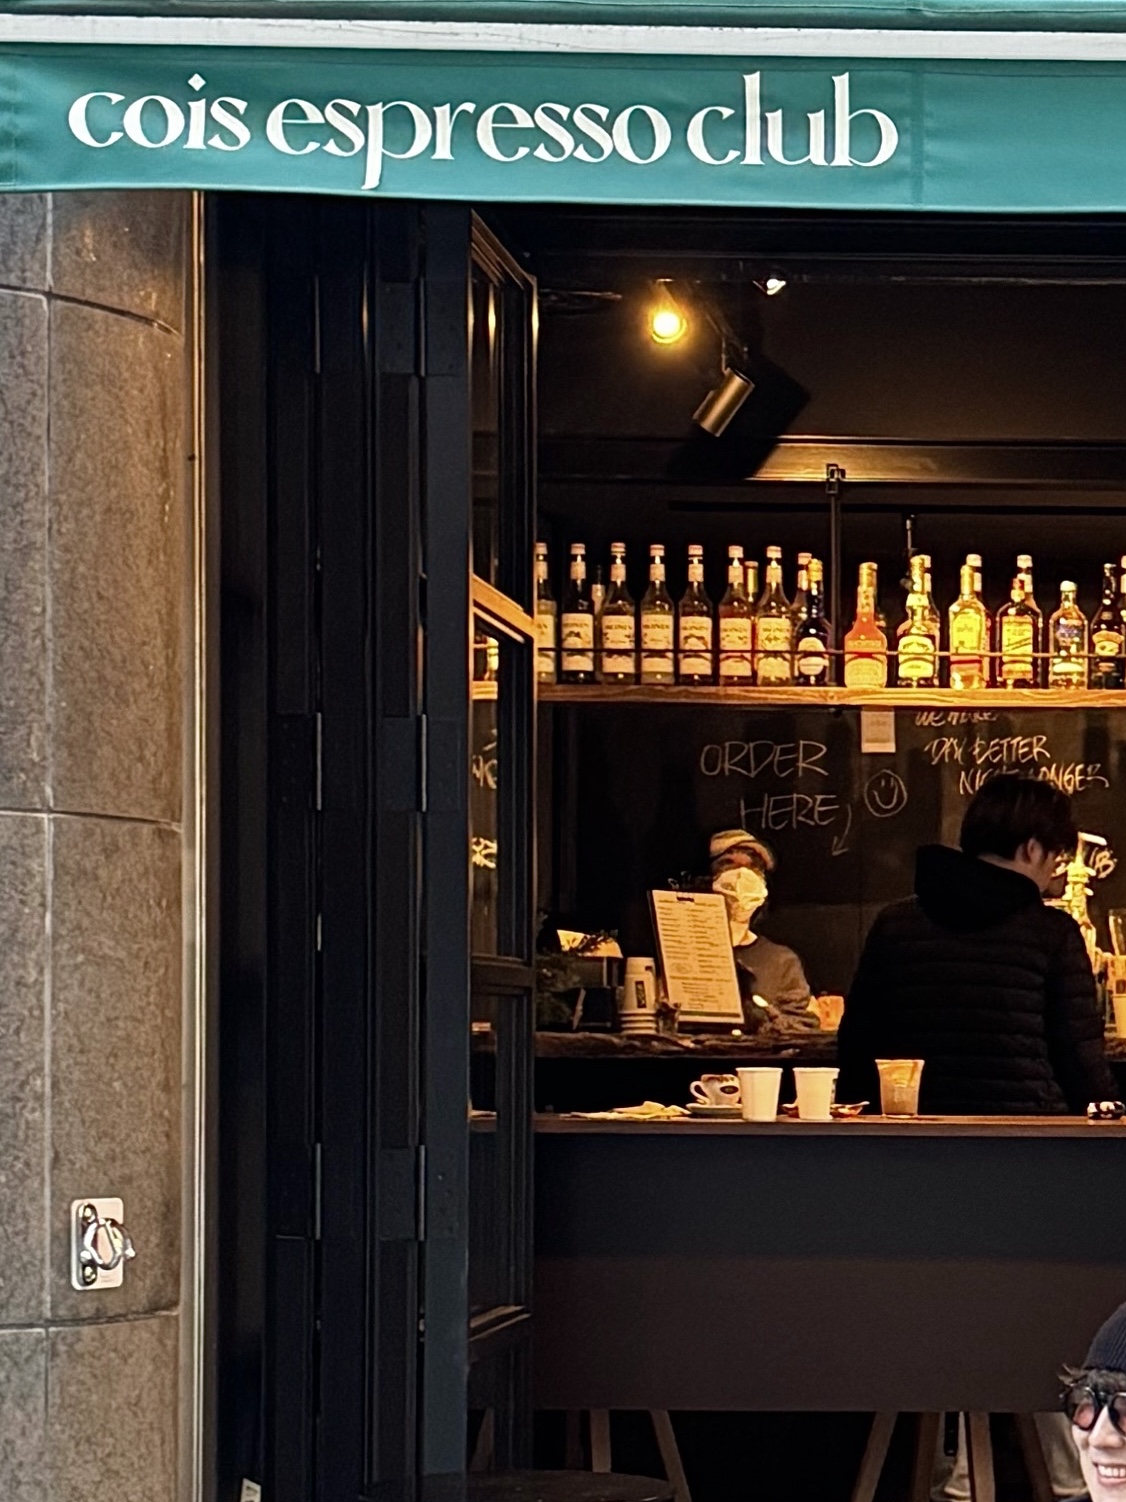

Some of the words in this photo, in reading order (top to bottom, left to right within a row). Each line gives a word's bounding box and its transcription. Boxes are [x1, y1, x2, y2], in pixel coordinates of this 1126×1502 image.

[68, 73, 251, 151] cois
[267, 101, 672, 191] espresso
[687, 71, 900, 168] club
[701, 740, 830, 778] ORDER
[740, 793, 840, 830] HERE
